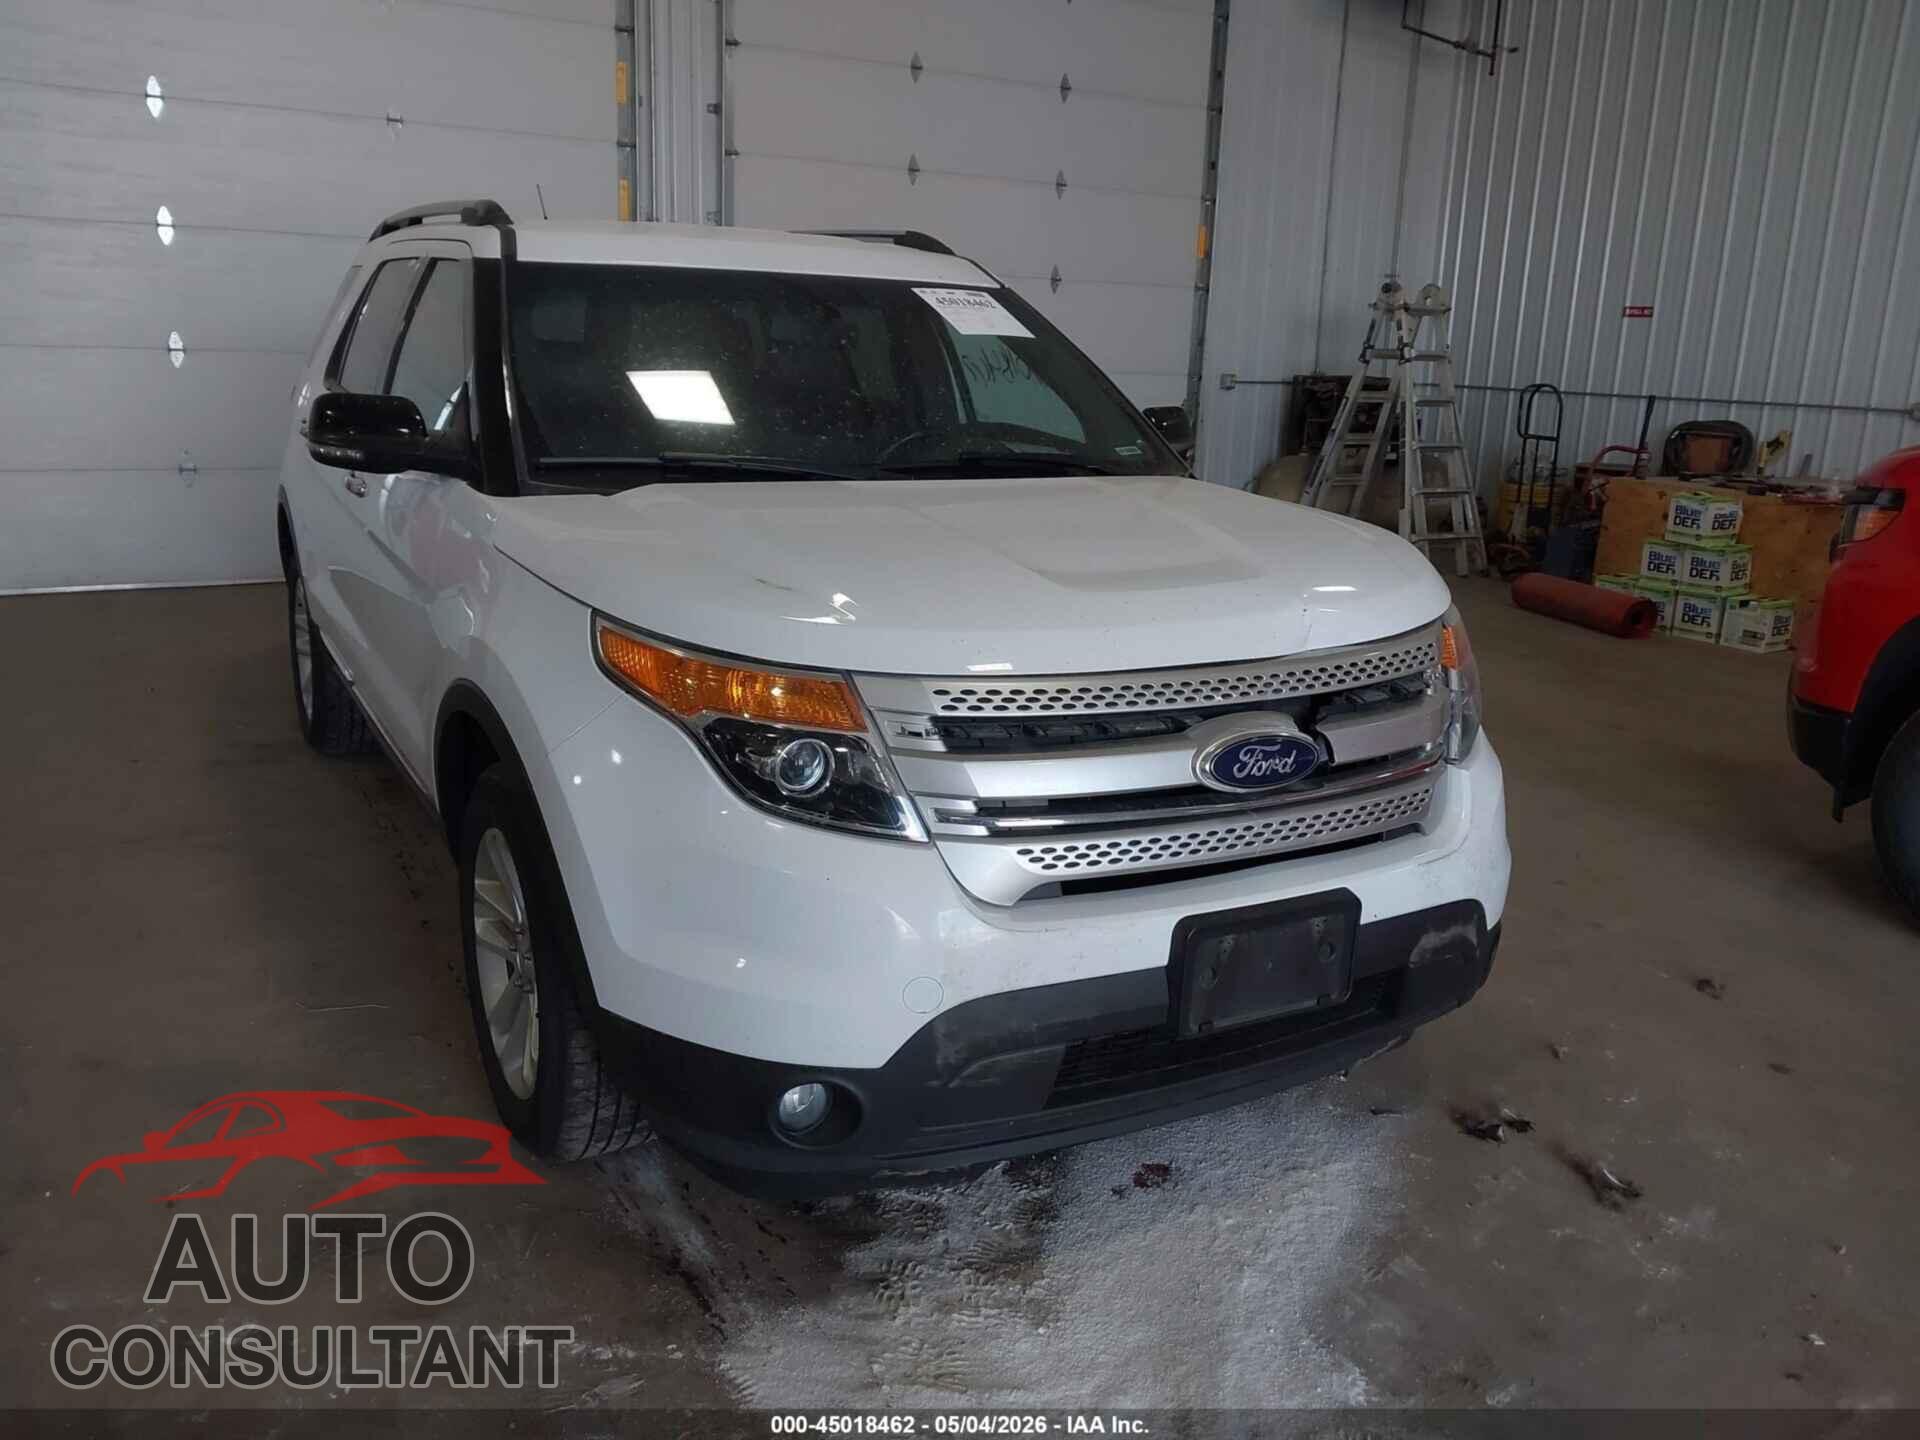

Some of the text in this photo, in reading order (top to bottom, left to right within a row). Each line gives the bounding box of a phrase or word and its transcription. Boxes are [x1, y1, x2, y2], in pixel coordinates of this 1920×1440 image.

[1675, 505, 1702, 516] Blue
[1673, 516, 1701, 529] DEF
[1712, 518, 1736, 530] DEF
[1648, 551, 1677, 563] Blue
[1691, 557, 1720, 569] Blue
[1647, 561, 1676, 575] DEF
[1689, 568, 1720, 582] DEF
[1683, 602, 1713, 614] Blue
[1681, 613, 1711, 627] DEF
[1232, 743, 1297, 778] Ford
